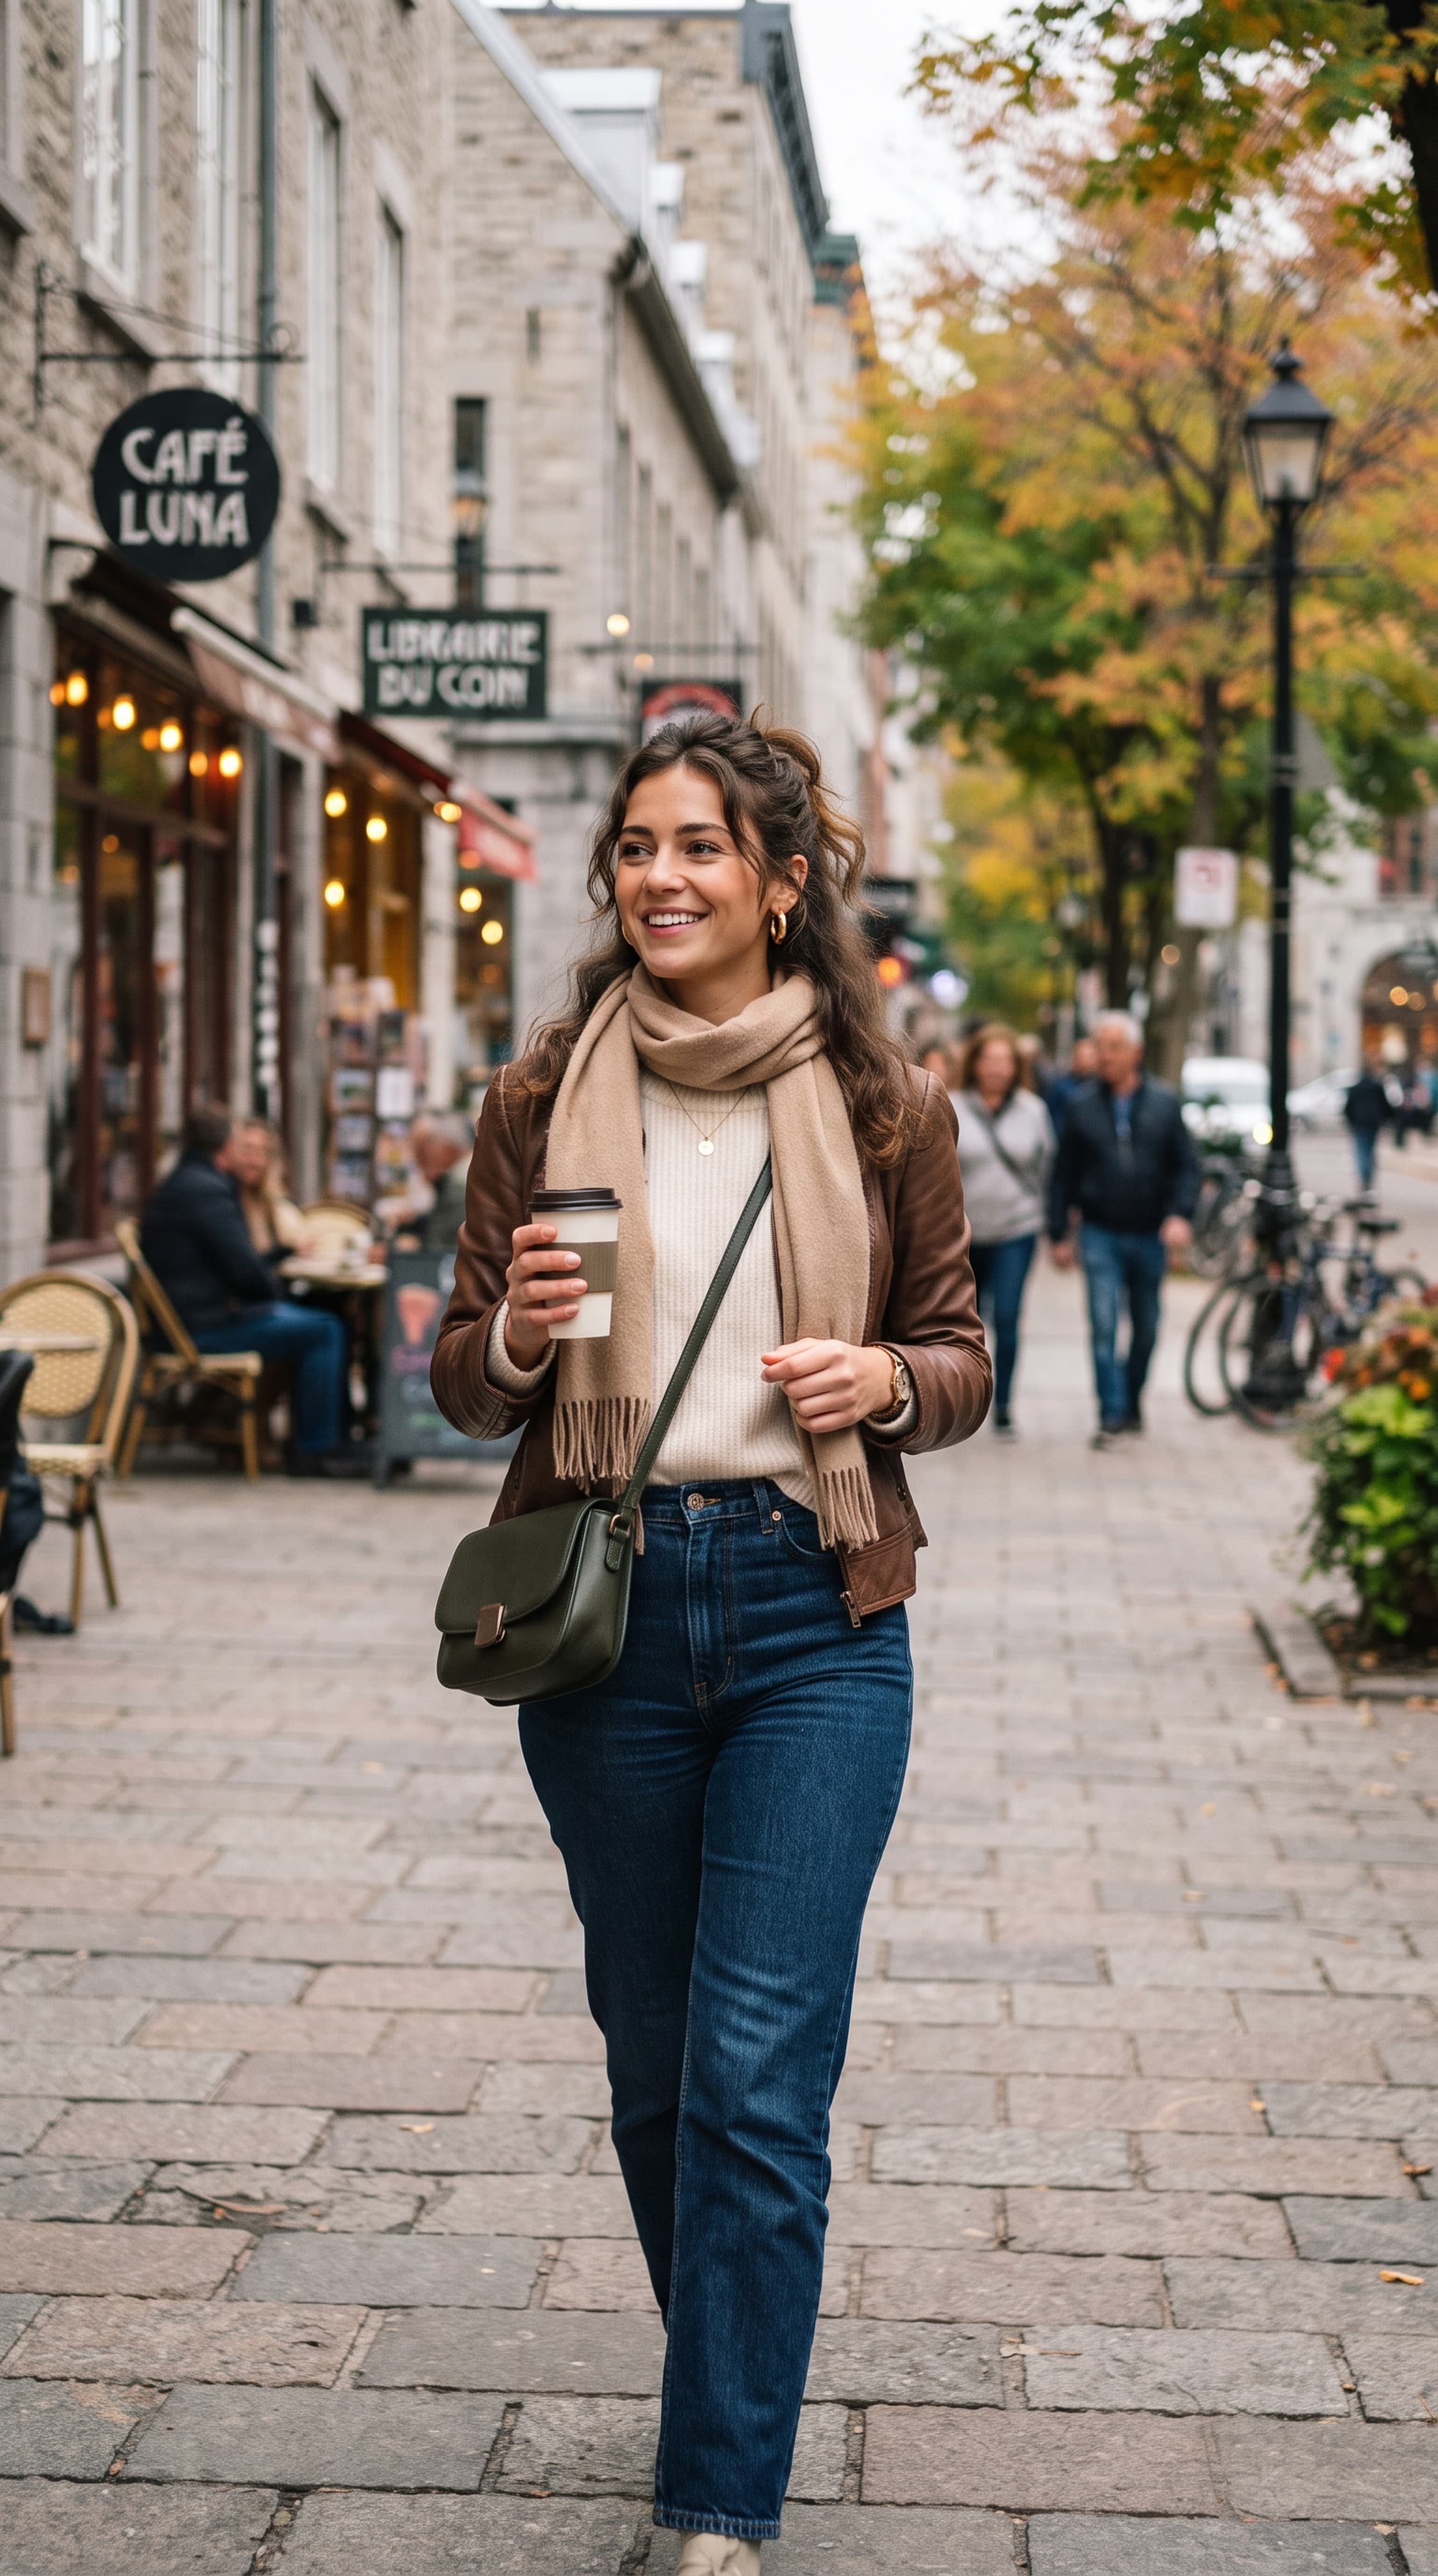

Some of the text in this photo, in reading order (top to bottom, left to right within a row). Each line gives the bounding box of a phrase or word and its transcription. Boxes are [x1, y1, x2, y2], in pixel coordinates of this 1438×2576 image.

[120, 416, 249, 485] CAFÉ
[118, 490, 250, 547] LUNA
[377, 664, 433, 707] DU
